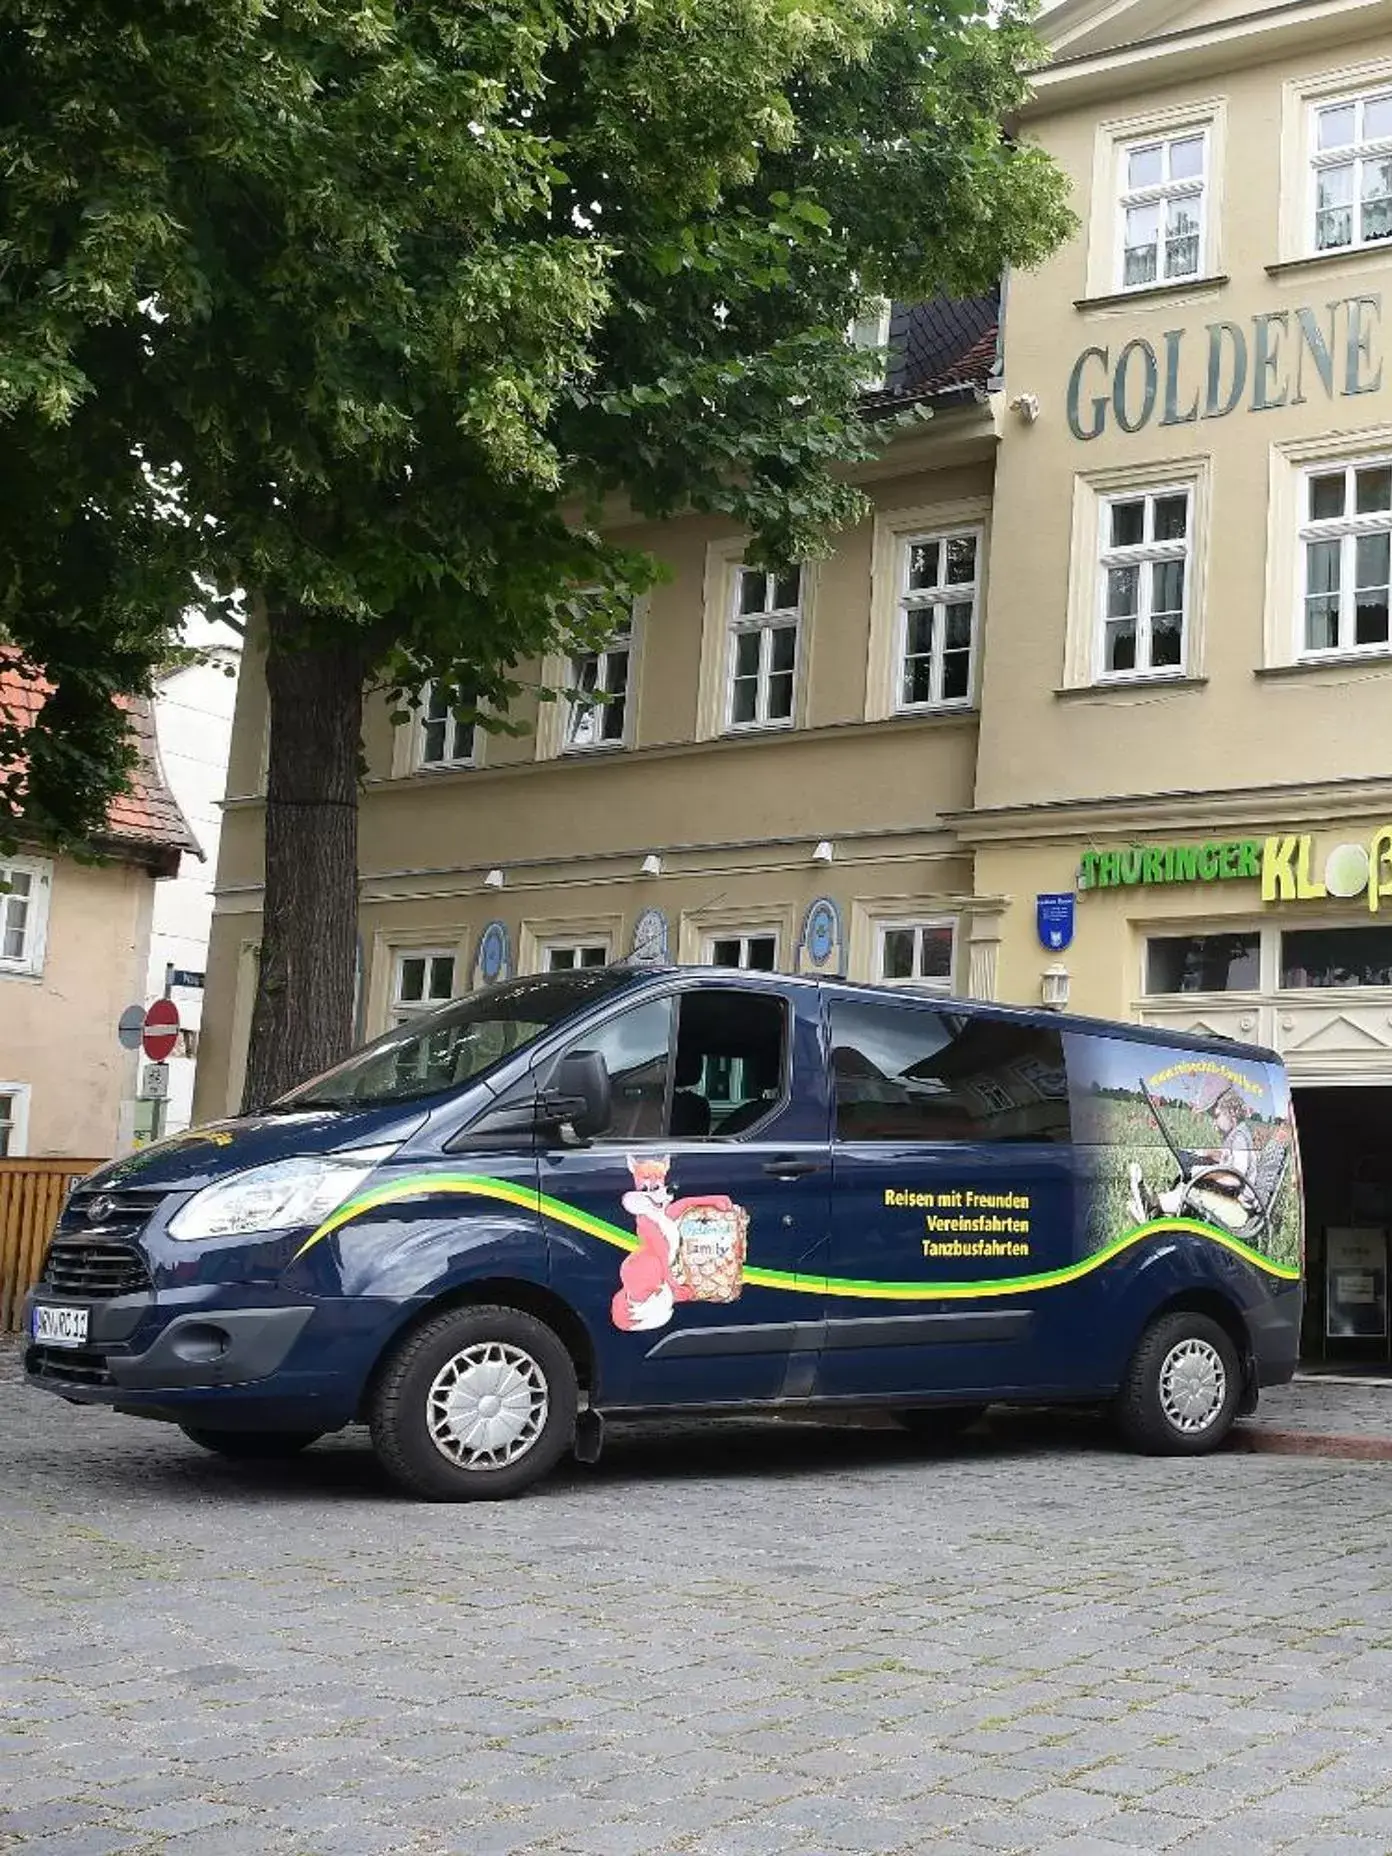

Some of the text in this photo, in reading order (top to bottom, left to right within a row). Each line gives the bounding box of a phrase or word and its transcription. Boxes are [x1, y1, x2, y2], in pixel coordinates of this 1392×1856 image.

[1066, 292, 1382, 441] GOLDENE
[884, 1189, 1030, 1209] Reisen mit Freunden
[926, 1215, 1030, 1233] Vereinsfahrten
[922, 1239, 1030, 1257] Tanzbusfahrten
